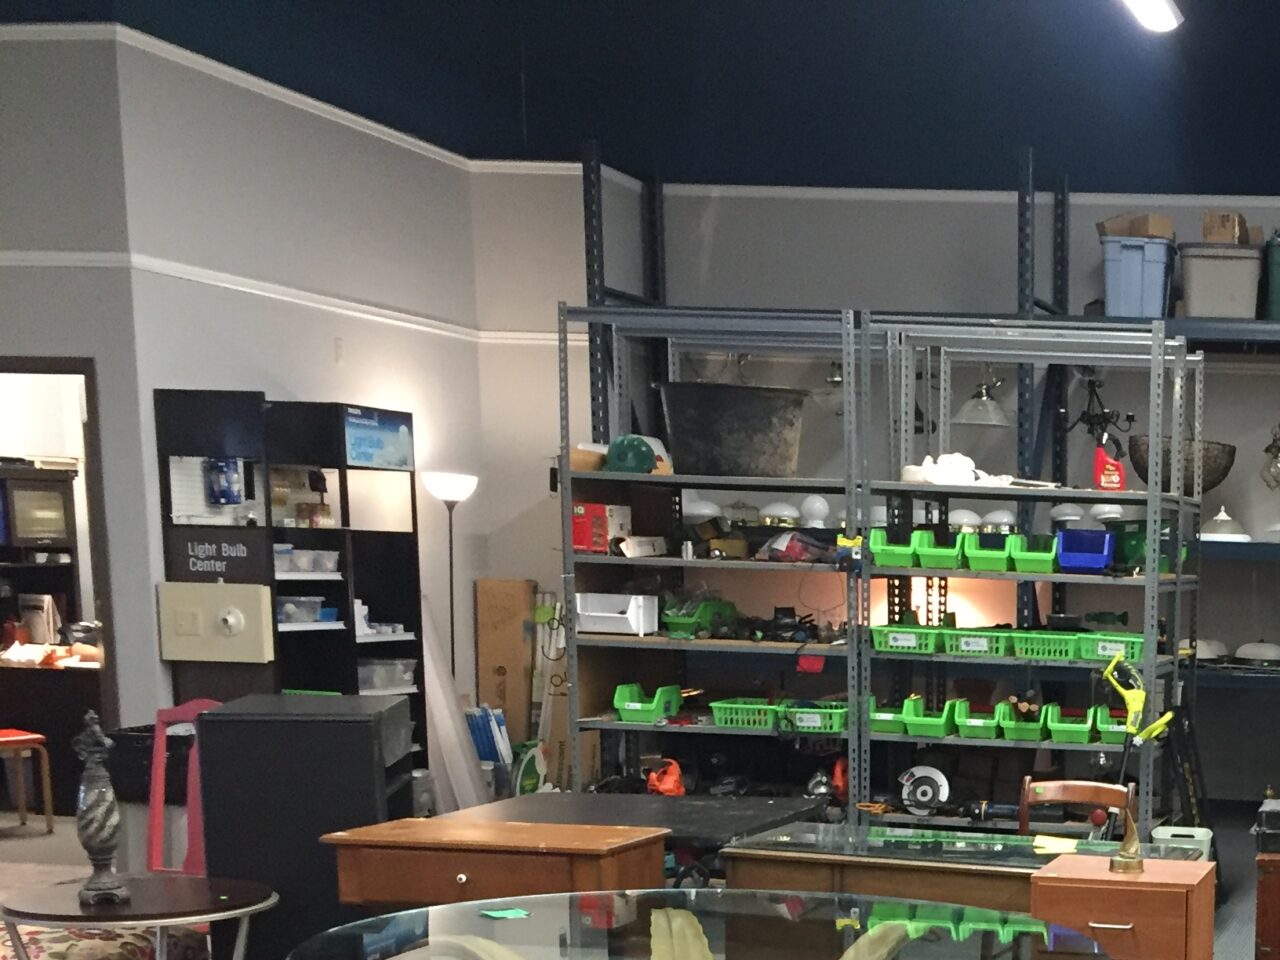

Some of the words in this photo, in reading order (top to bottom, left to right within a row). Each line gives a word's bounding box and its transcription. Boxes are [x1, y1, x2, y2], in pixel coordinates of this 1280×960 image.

[187, 542, 217, 558] Light
[221, 542, 247, 557] Bulb
[189, 557, 227, 572] Center
